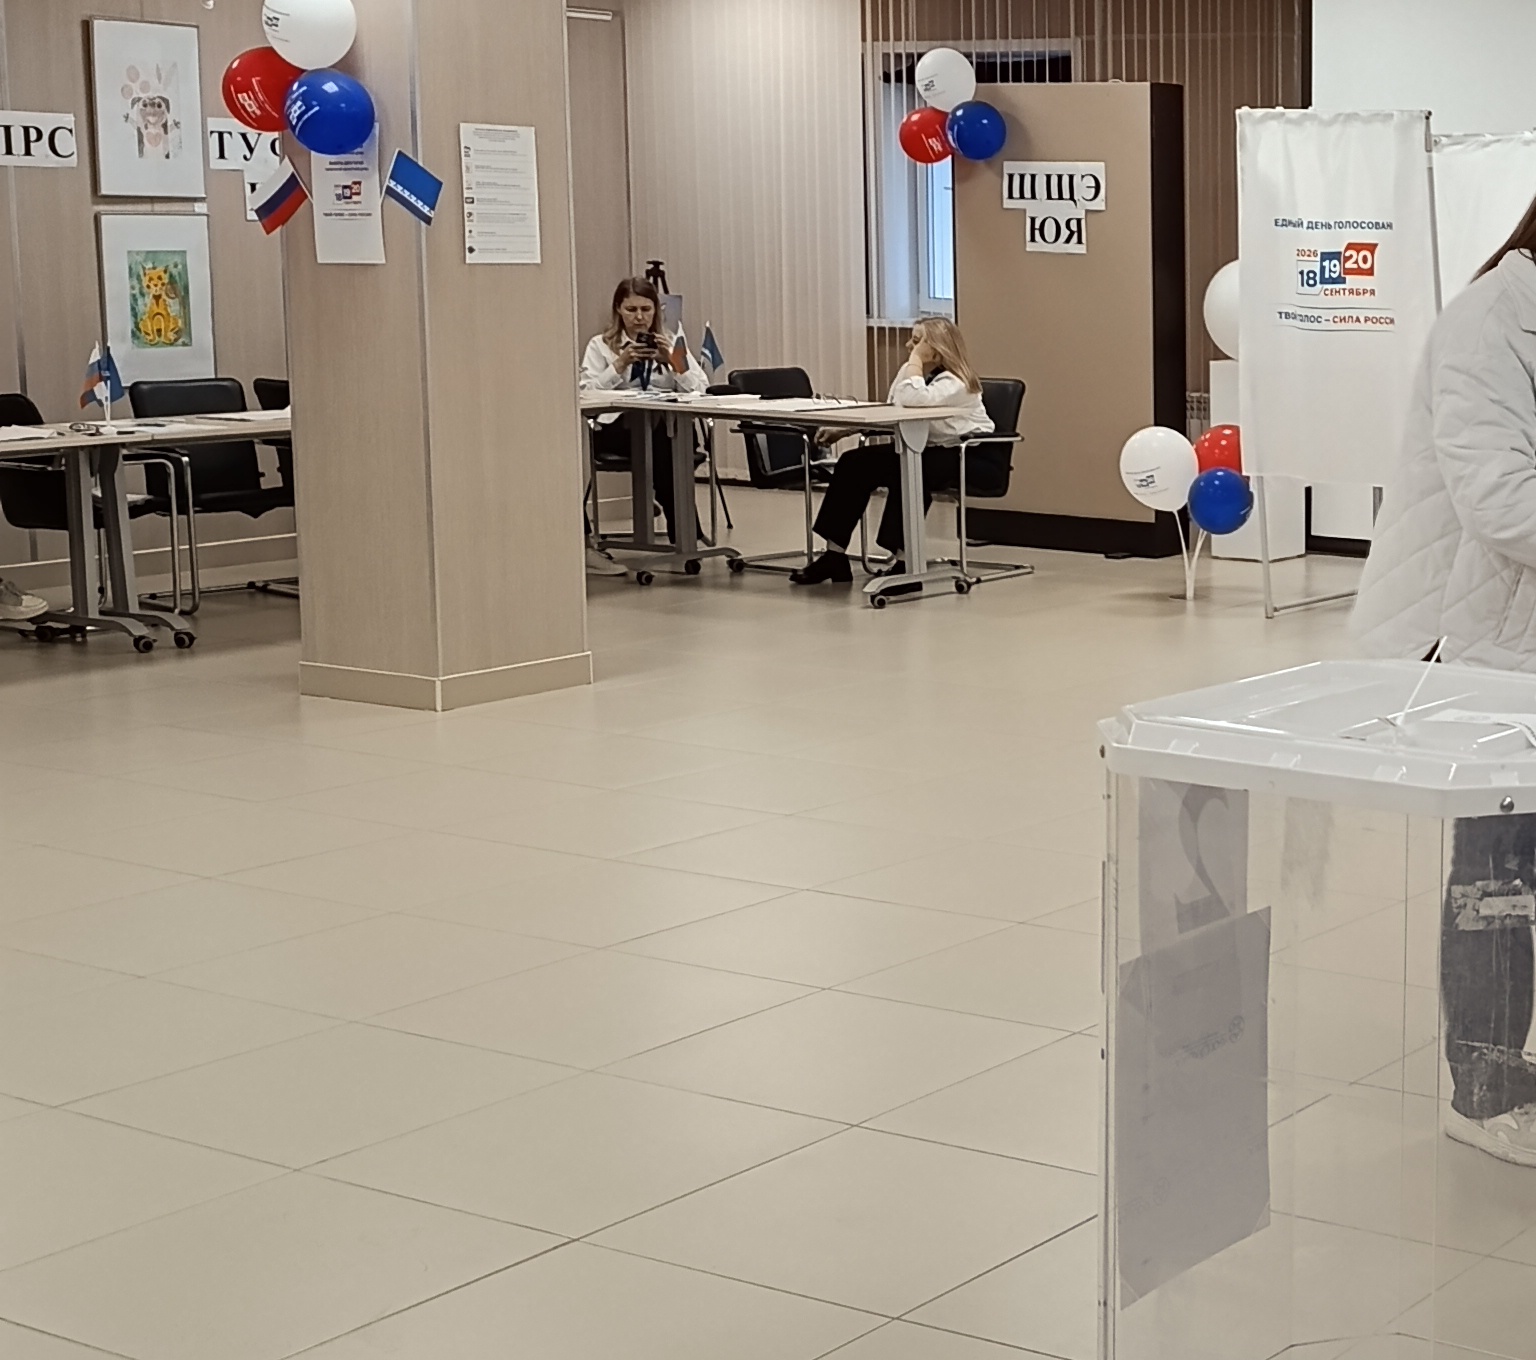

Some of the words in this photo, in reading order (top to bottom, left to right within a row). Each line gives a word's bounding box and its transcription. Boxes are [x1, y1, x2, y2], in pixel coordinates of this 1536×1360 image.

[1306, 220, 1333, 230] ДЕНЬ
[1028, 216, 1084, 245] ЮЯ
[1296, 248, 1319, 258] 2026
[1298, 269, 1318, 288] 18
[1322, 259, 1341, 279] 19
[1344, 249, 1373, 270] 20
[1323, 288, 1376, 297] СЕНТЯБРЯ
[1332, 315, 1362, 324] СИЛА
